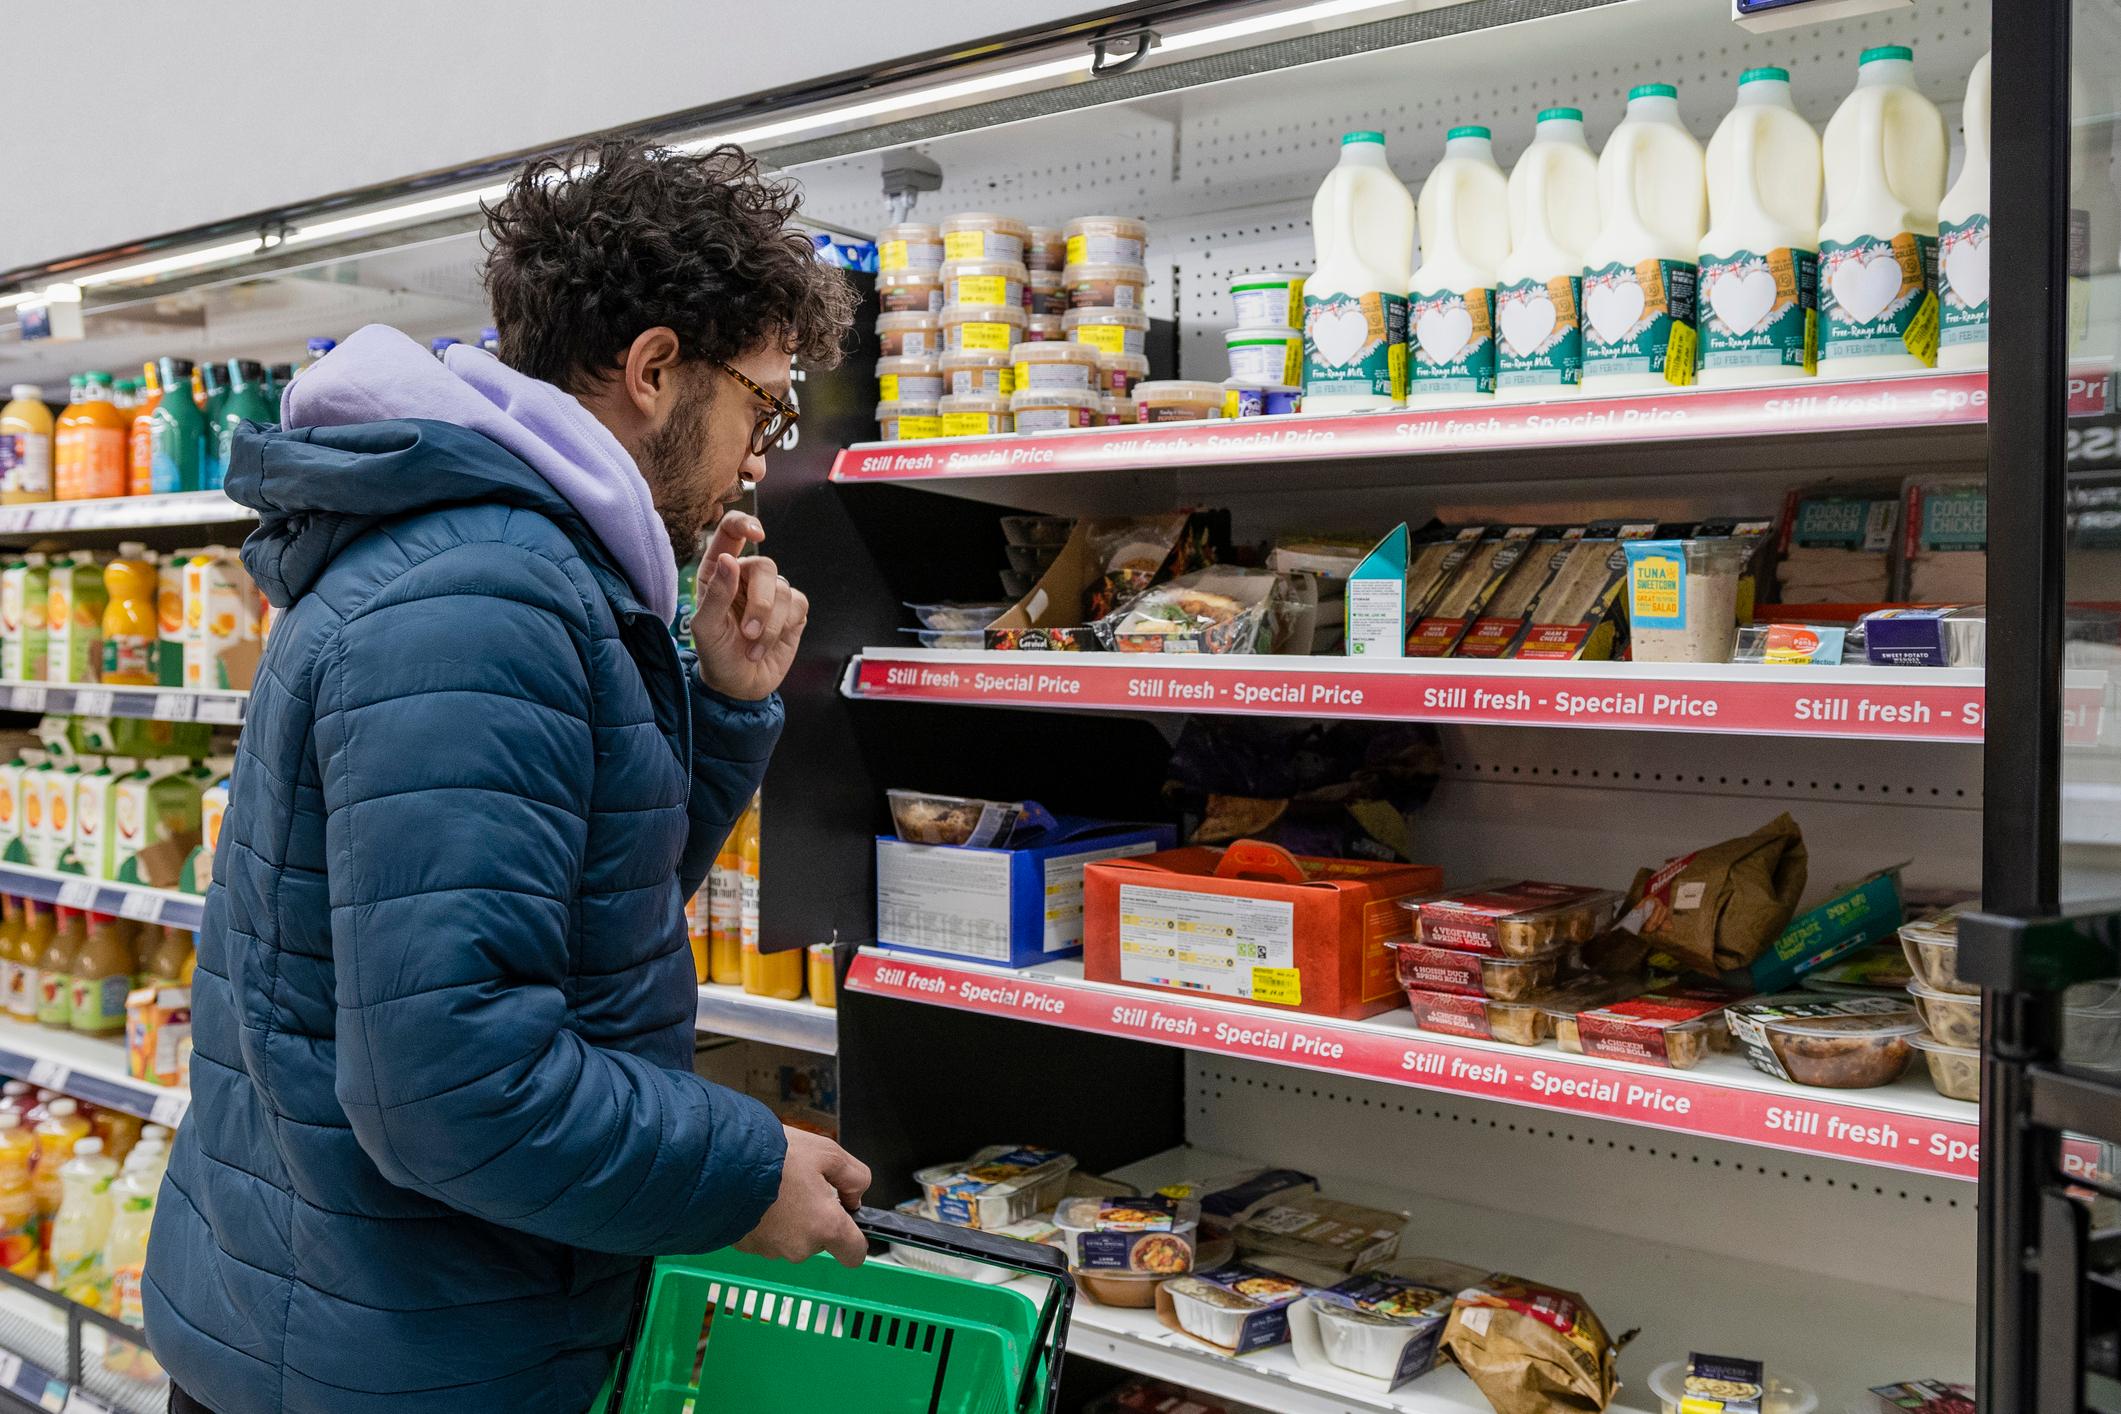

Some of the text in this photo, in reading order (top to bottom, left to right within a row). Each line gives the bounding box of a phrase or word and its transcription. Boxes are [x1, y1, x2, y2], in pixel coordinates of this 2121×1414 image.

[1946, 310, 1984, 323] Free-Range
[1832, 324, 1900, 339] Free-Range Milk
[1710, 335, 1774, 350] Free-Range Milk
[1846, 342, 1861, 354] FEB
[1587, 344, 1642, 360] Free-Range Milk
[1725, 355, 1737, 363] FEB
[1500, 357, 1553, 371] Free-Range Milk
[1312, 367, 1365, 382] Free-Range Milk
[1417, 365, 1470, 380] Free-Range Milk
[1765, 397, 1824, 420] Still
[1829, 392, 1897, 416] fresh
[1396, 421, 1437, 441] Still
[1444, 418, 1500, 438] fresh
[1526, 410, 1617, 437] Special
[1624, 406, 1687, 428] Price
[1103, 440, 1138, 457] Still
[1141, 437, 1188, 455] fresh
[1207, 432, 1278, 453] Special
[1283, 428, 1334, 447] Price
[861, 455, 895, 473] Still
[898, 452, 933, 471] fresh
[948, 448, 1008, 469] Special
[1011, 446, 1054, 464] Price
[1638, 568, 1666, 578] TUNA
[1638, 581, 1676, 590] SWEETCORN
[1652, 603, 1677, 613] SALAD
[887, 668, 918, 688] Still
[921, 671, 960, 690] fresh
[974, 673, 1034, 694] Special
[1038, 676, 1080, 694] Price
[1128, 679, 1163, 698] Still
[1168, 680, 1214, 699] fresh
[1234, 683, 1305, 705] Special
[1311, 685, 1363, 705] Price
[1423, 688, 1466, 709] Still
[1473, 688, 1531, 711] fresh
[1555, 692, 1644, 716] Special
[1653, 693, 1718, 717] Price
[1794, 698, 1849, 722] Still
[1857, 699, 1930, 724] fresh
[1962, 703, 1984, 727] S
[1432, 933, 1492, 948] SPRING ROLLS
[1439, 928, 1487, 940] VEGETABLE
[1416, 972, 1468, 985] SPRING ROLLS
[1447, 970, 1469, 979] DUCK
[874, 967, 904, 986] Still
[907, 972, 945, 994] fresh
[960, 981, 1020, 1008] Special
[1022, 991, 1065, 1014] Price
[1427, 1015, 1475, 1029] SPRING ROLLS
[1436, 1012, 1468, 1022] CHICKEN
[1112, 1006, 1146, 1029] Still
[1151, 1011, 1197, 1036] fresh
[1215, 1022, 1288, 1052] Special
[1292, 1034, 1344, 1059] Price
[1596, 1043, 1652, 1058] SPRING ROLLS
[1607, 1039, 1643, 1050] CHICKEN
[1402, 1050, 1445, 1075] Still
[1450, 1057, 1507, 1084] fresh
[1530, 1070, 1619, 1103] Special
[1627, 1085, 1691, 1114] Price
[1765, 1106, 1818, 1135] Still
[1827, 1116, 1898, 1148] fresh
